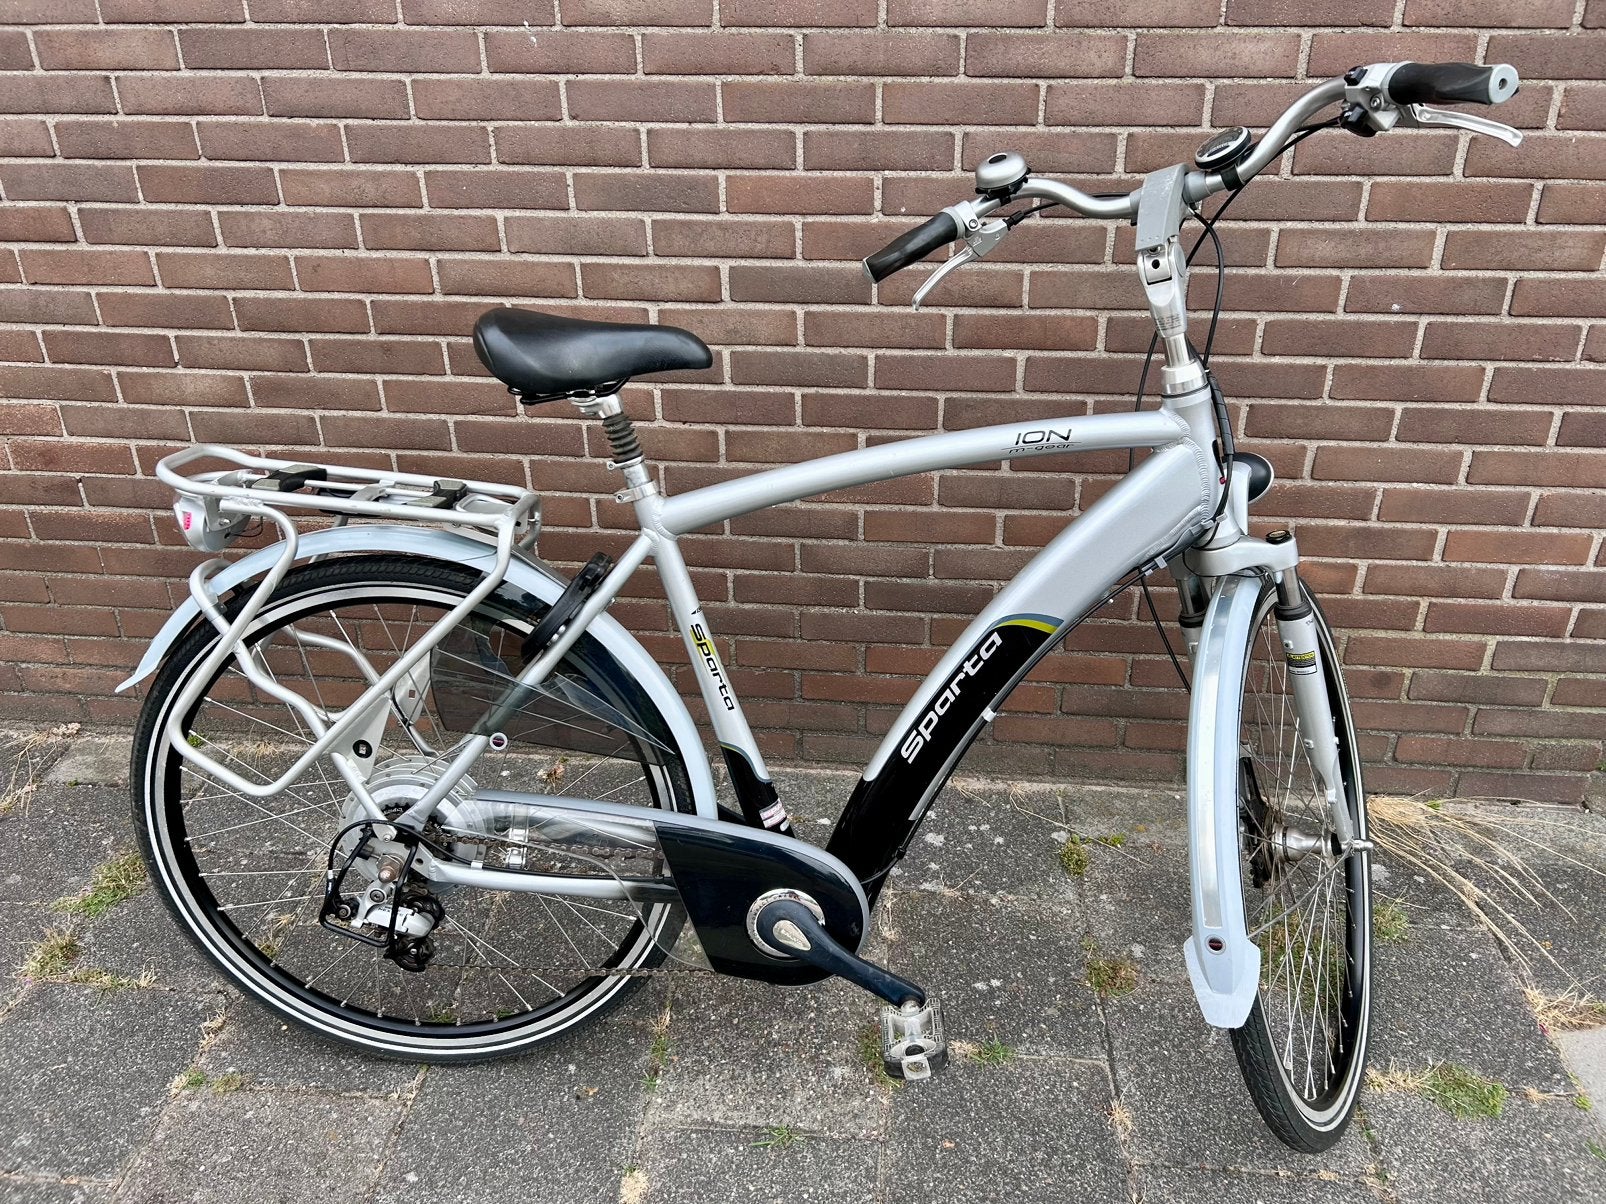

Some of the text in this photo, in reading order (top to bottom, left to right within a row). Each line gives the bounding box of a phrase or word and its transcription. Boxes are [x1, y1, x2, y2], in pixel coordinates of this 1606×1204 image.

[1008, 444, 1074, 454] m-gear
[1014, 428, 1073, 446] ION
[690, 623, 735, 711] Sparta
[900, 631, 1003, 765] Sparta
